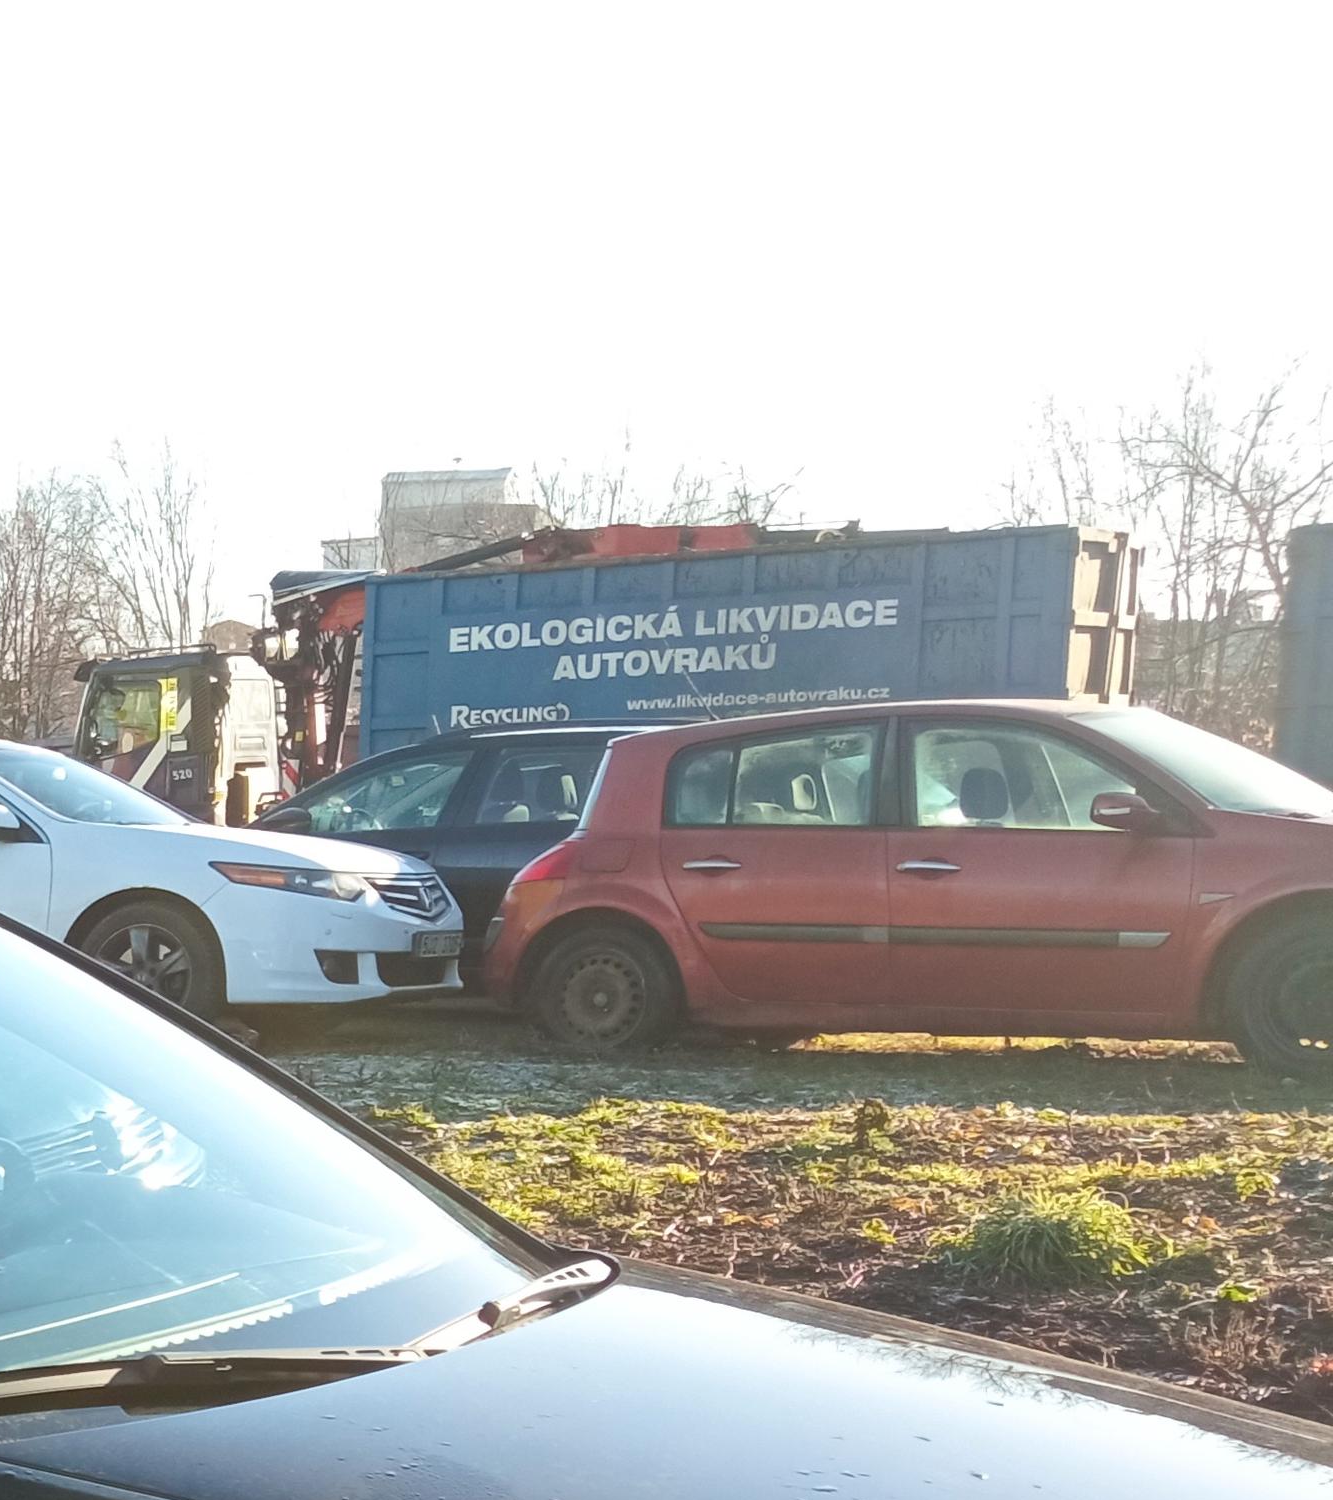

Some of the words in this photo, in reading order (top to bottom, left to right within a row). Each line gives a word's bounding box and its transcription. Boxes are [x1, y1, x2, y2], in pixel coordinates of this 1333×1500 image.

[448, 605, 683, 654] EKOLOGICKÁ
[694, 599, 900, 637] LIKVIDACE
[551, 633, 777, 682] AUTOVRAKŮ
[626, 686, 891, 711] www.likvidace-autovraku.cz
[172, 768, 193, 781] 520
